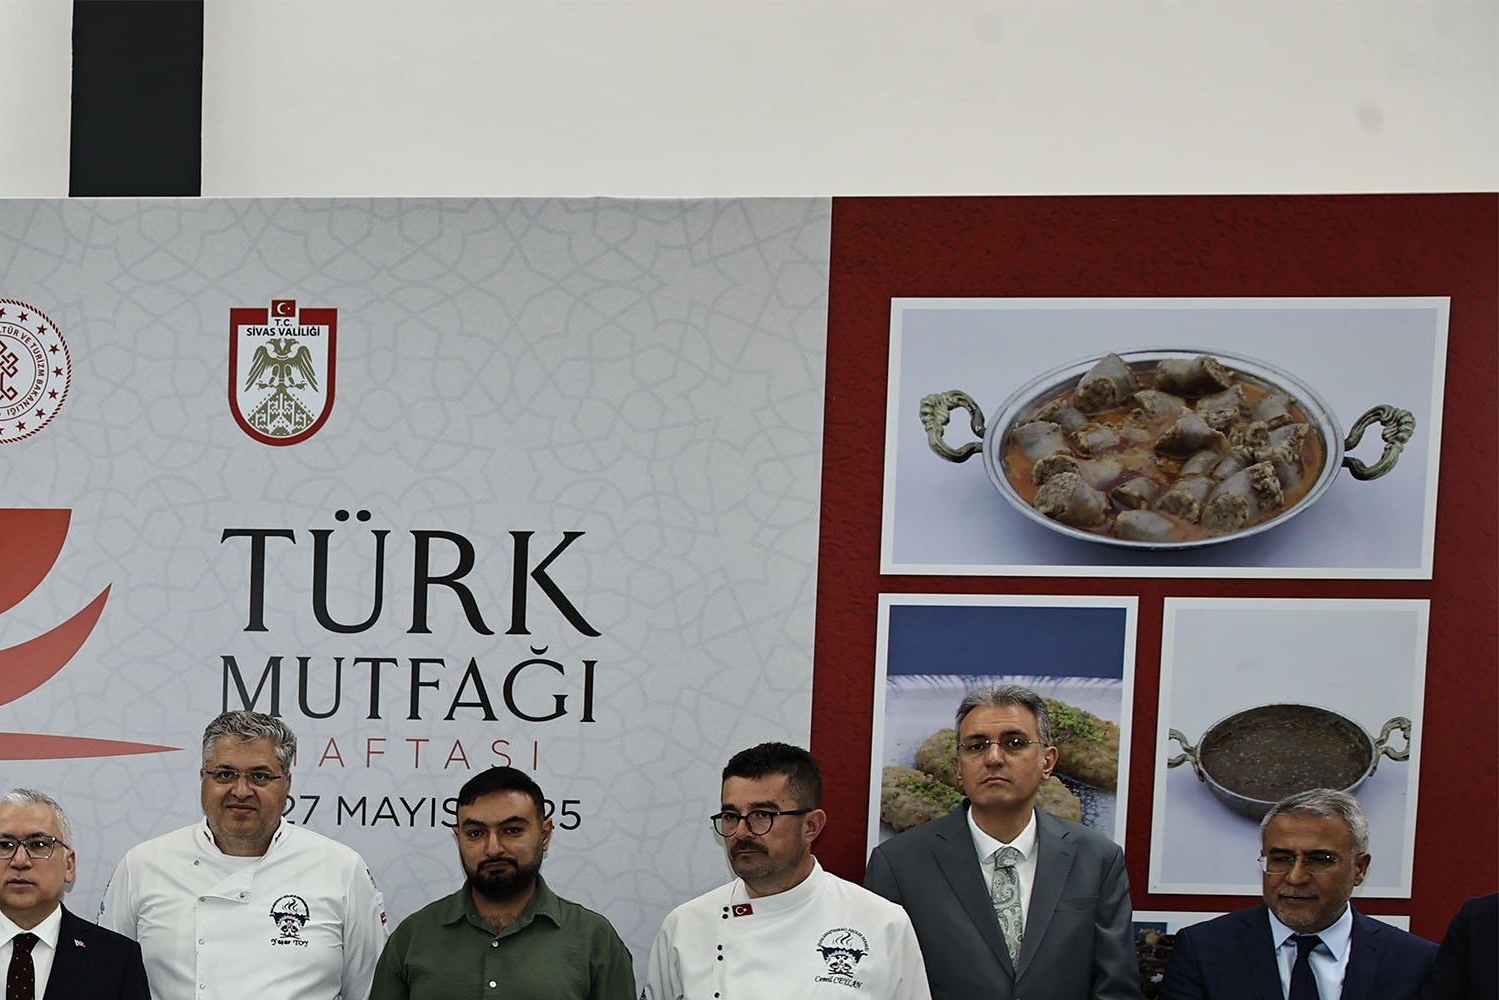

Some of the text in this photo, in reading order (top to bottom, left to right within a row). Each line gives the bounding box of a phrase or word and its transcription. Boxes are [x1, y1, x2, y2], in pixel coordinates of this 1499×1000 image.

[20, 332, 30, 344] VE
[246, 326, 320, 336] SİVAS VALİLİĞİ
[274, 318, 292, 326] T.C.
[30, 341, 46, 377] TURİZM
[6, 379, 45, 416] BAKANLIĞI
[220, 509, 602, 637] TÜRK
[220, 645, 598, 723] MUTFAĞI
[294, 737, 539, 770] AFTASI
[337, 796, 458, 828] MAYIS
[543, 799, 581, 830] 25
